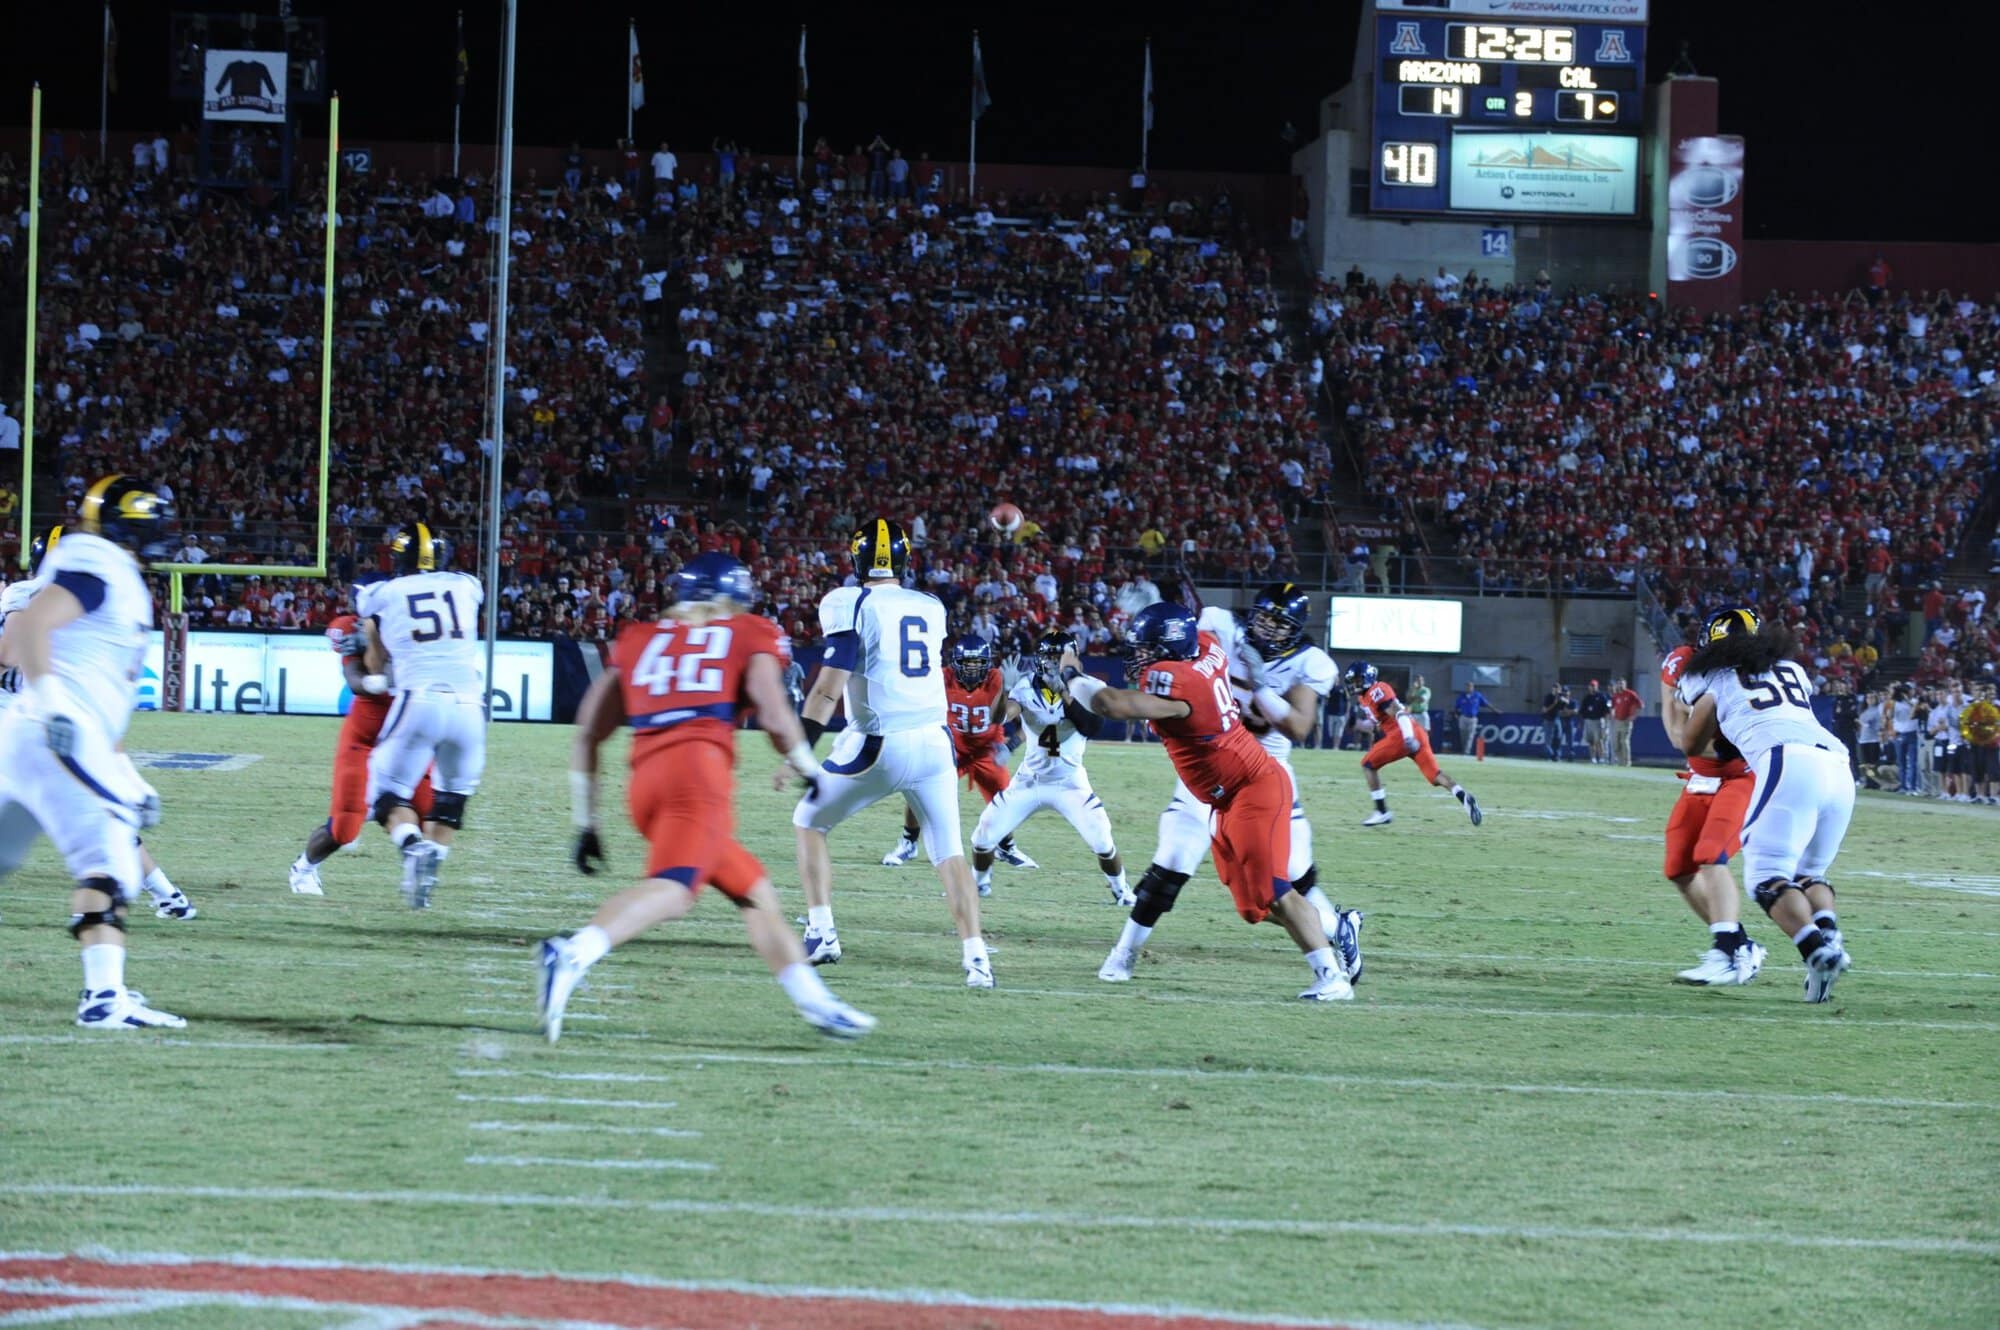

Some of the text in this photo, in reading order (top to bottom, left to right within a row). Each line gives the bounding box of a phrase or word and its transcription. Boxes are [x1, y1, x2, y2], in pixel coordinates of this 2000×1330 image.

[1464, 26, 1572, 62] 12:26
[1400, 61, 1480, 84] ARIZONA
[1560, 67, 1597, 89] CAL
[1433, 88, 1460, 115] 14
[1515, 92, 1532, 116] 2
[1575, 93, 1594, 120] 7
[344, 153, 369, 172] 12
[1383, 145, 1435, 184] 40
[1483, 233, 1507, 253] 14
[407, 590, 464, 642] 51
[631, 626, 733, 695] 42
[899, 615, 931, 678] 6
[166, 617, 183, 709] WILDCATS
[1736, 666, 1810, 711] 58
[951, 703, 991, 734] 33
[1038, 724, 1060, 757] 4
